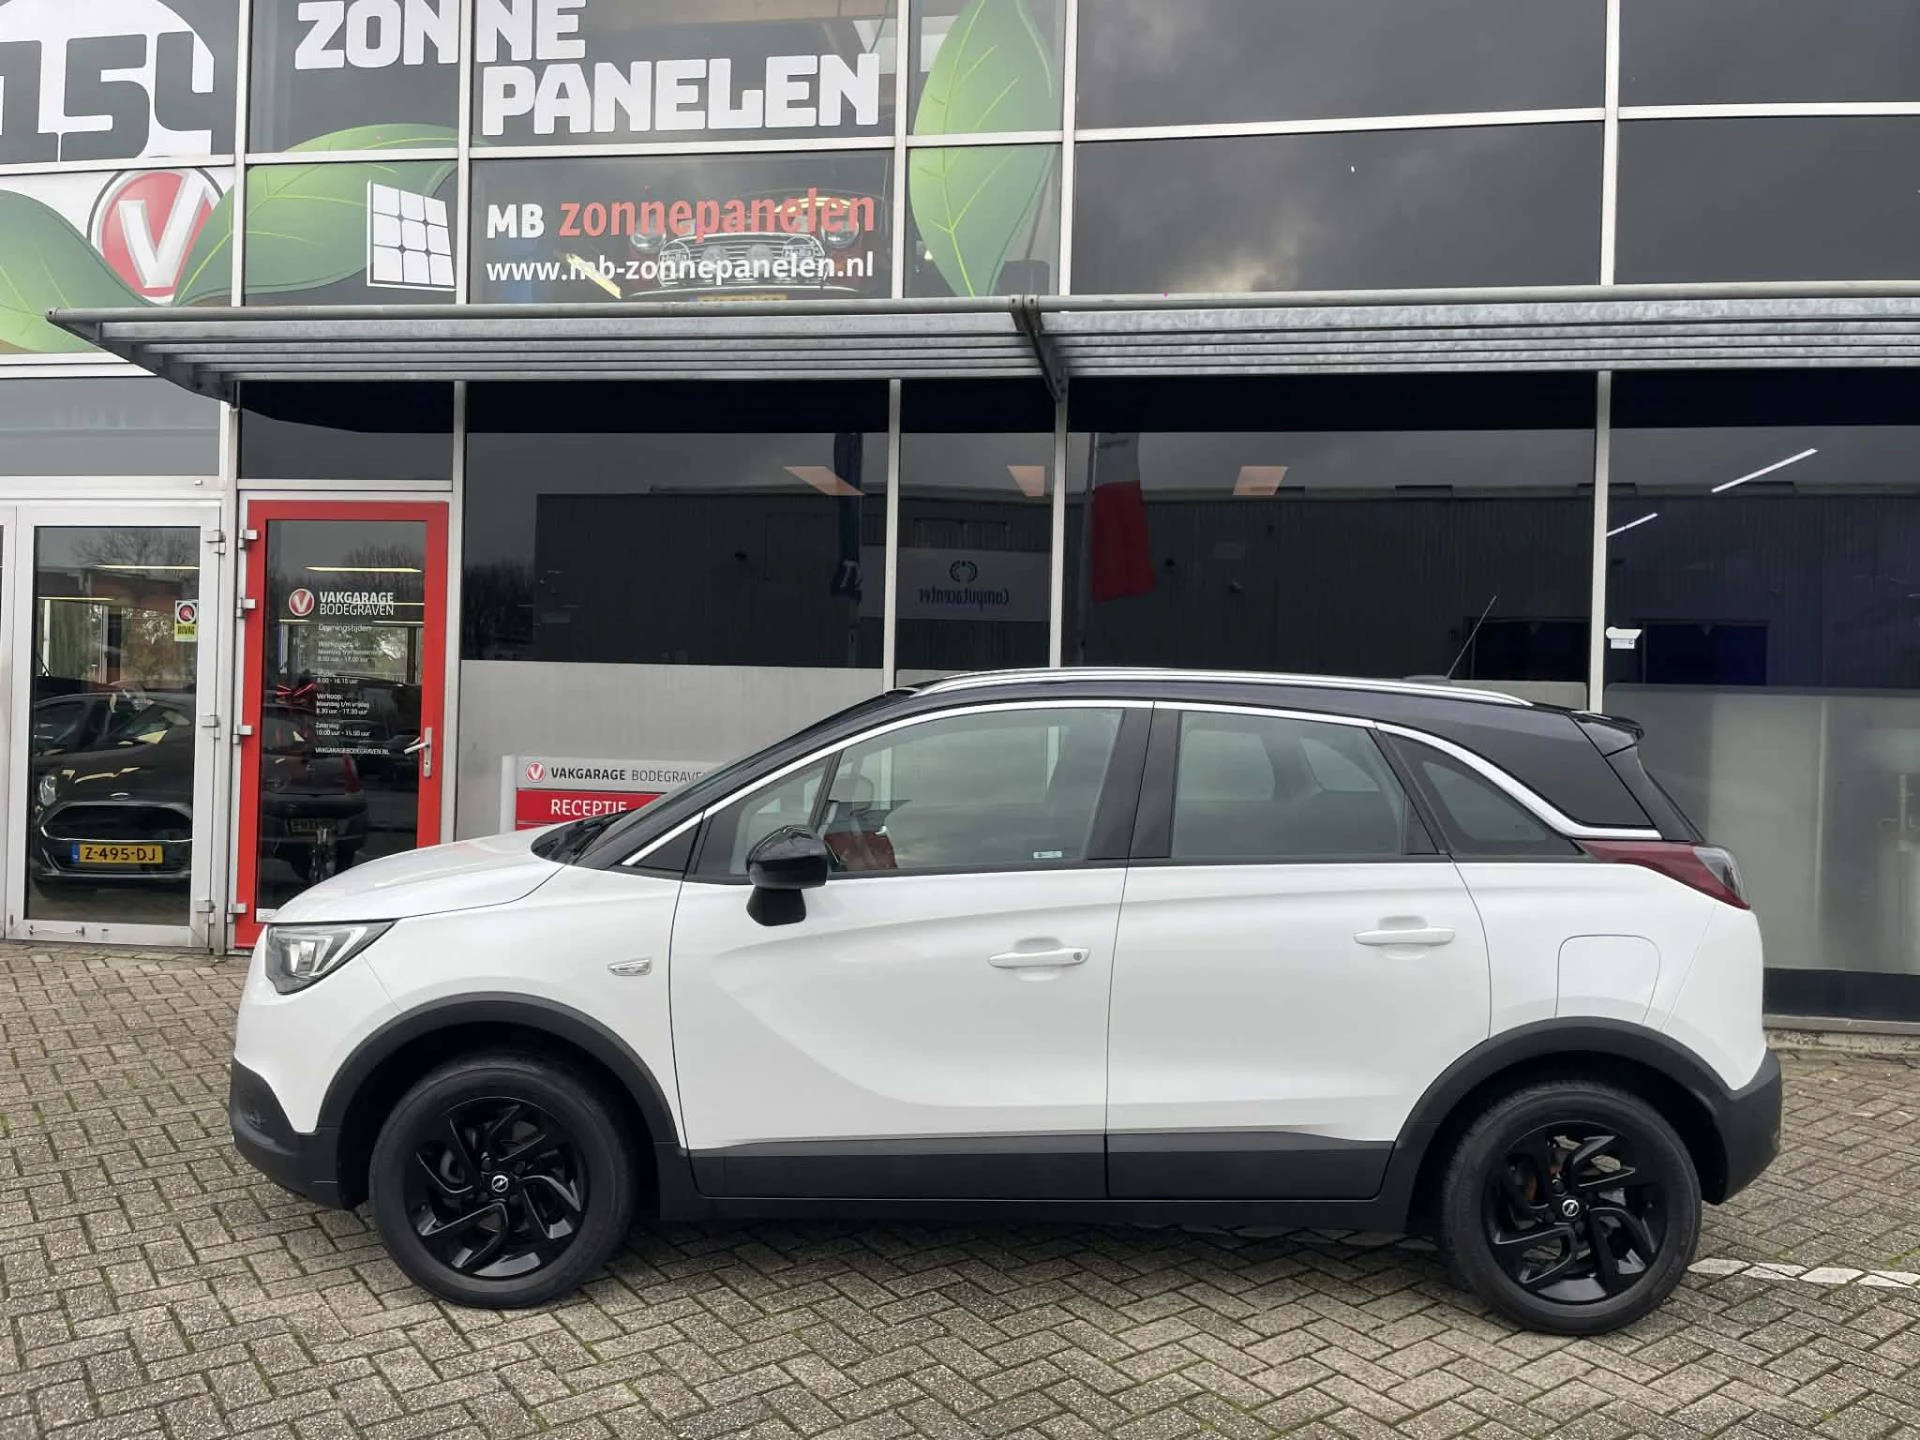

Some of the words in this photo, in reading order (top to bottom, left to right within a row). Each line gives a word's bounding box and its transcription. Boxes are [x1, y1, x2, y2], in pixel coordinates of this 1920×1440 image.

[295, 0, 586, 69] ZONNE
[482, 53, 879, 136] PANELEN
[487, 204, 544, 239] MB
[559, 187, 875, 243] zonnepanelen
[487, 251, 874, 287] www.mb-zonnepanelen.nl
[320, 592, 394, 603] VAKGARAGE
[320, 603, 394, 616] BODEGRAVEN
[551, 767, 626, 781] VAKGARAGE
[631, 769, 704, 783] BODEGRAVE
[85, 846, 156, 861] Z-495-DJ
